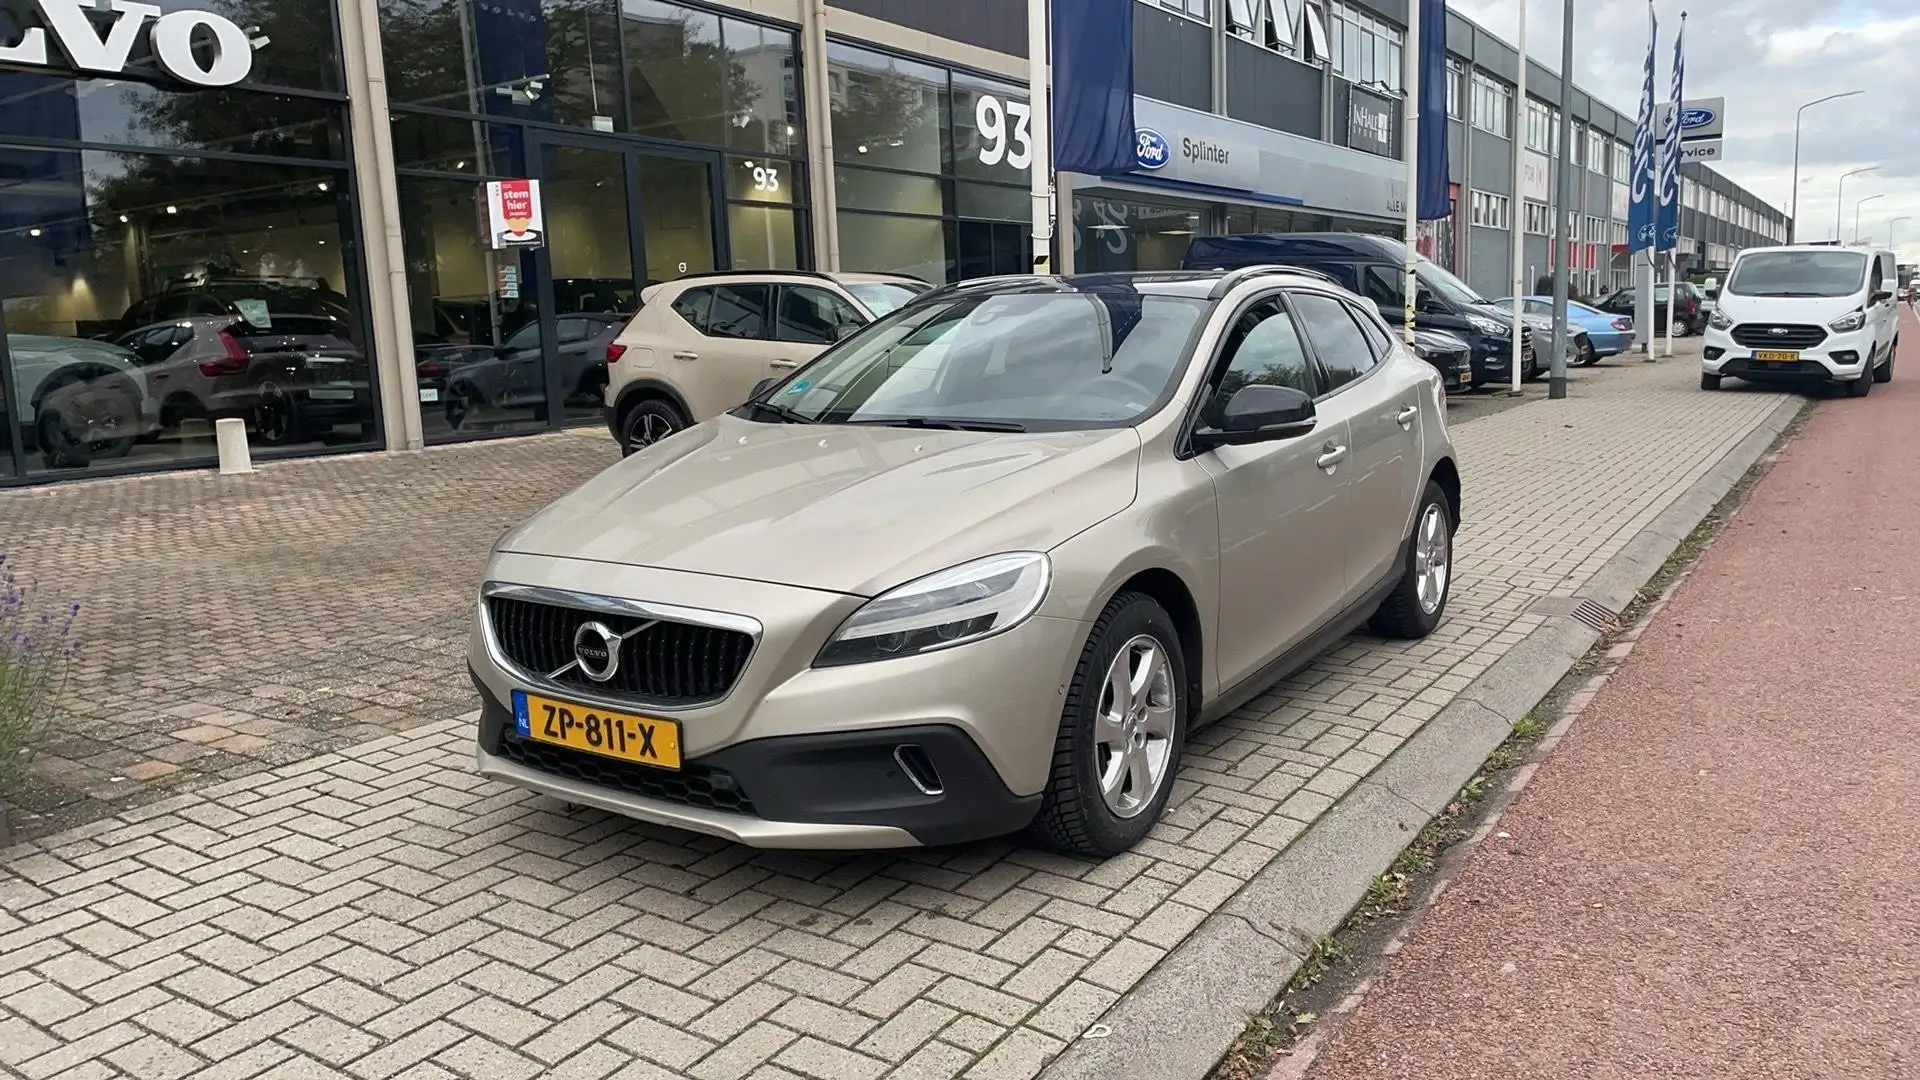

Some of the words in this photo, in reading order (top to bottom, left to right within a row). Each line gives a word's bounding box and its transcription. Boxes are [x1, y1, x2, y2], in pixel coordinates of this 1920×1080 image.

[975, 95, 1033, 170] 93
[1136, 132, 1164, 161] Ford
[1182, 136, 1230, 165] Splinter
[752, 166, 780, 193] 93
[503, 190, 529, 200] stem
[506, 200, 528, 210] hier
[578, 646, 607, 658] VOLVO
[518, 718, 529, 729] NL
[542, 704, 658, 759] ZP-811-X
